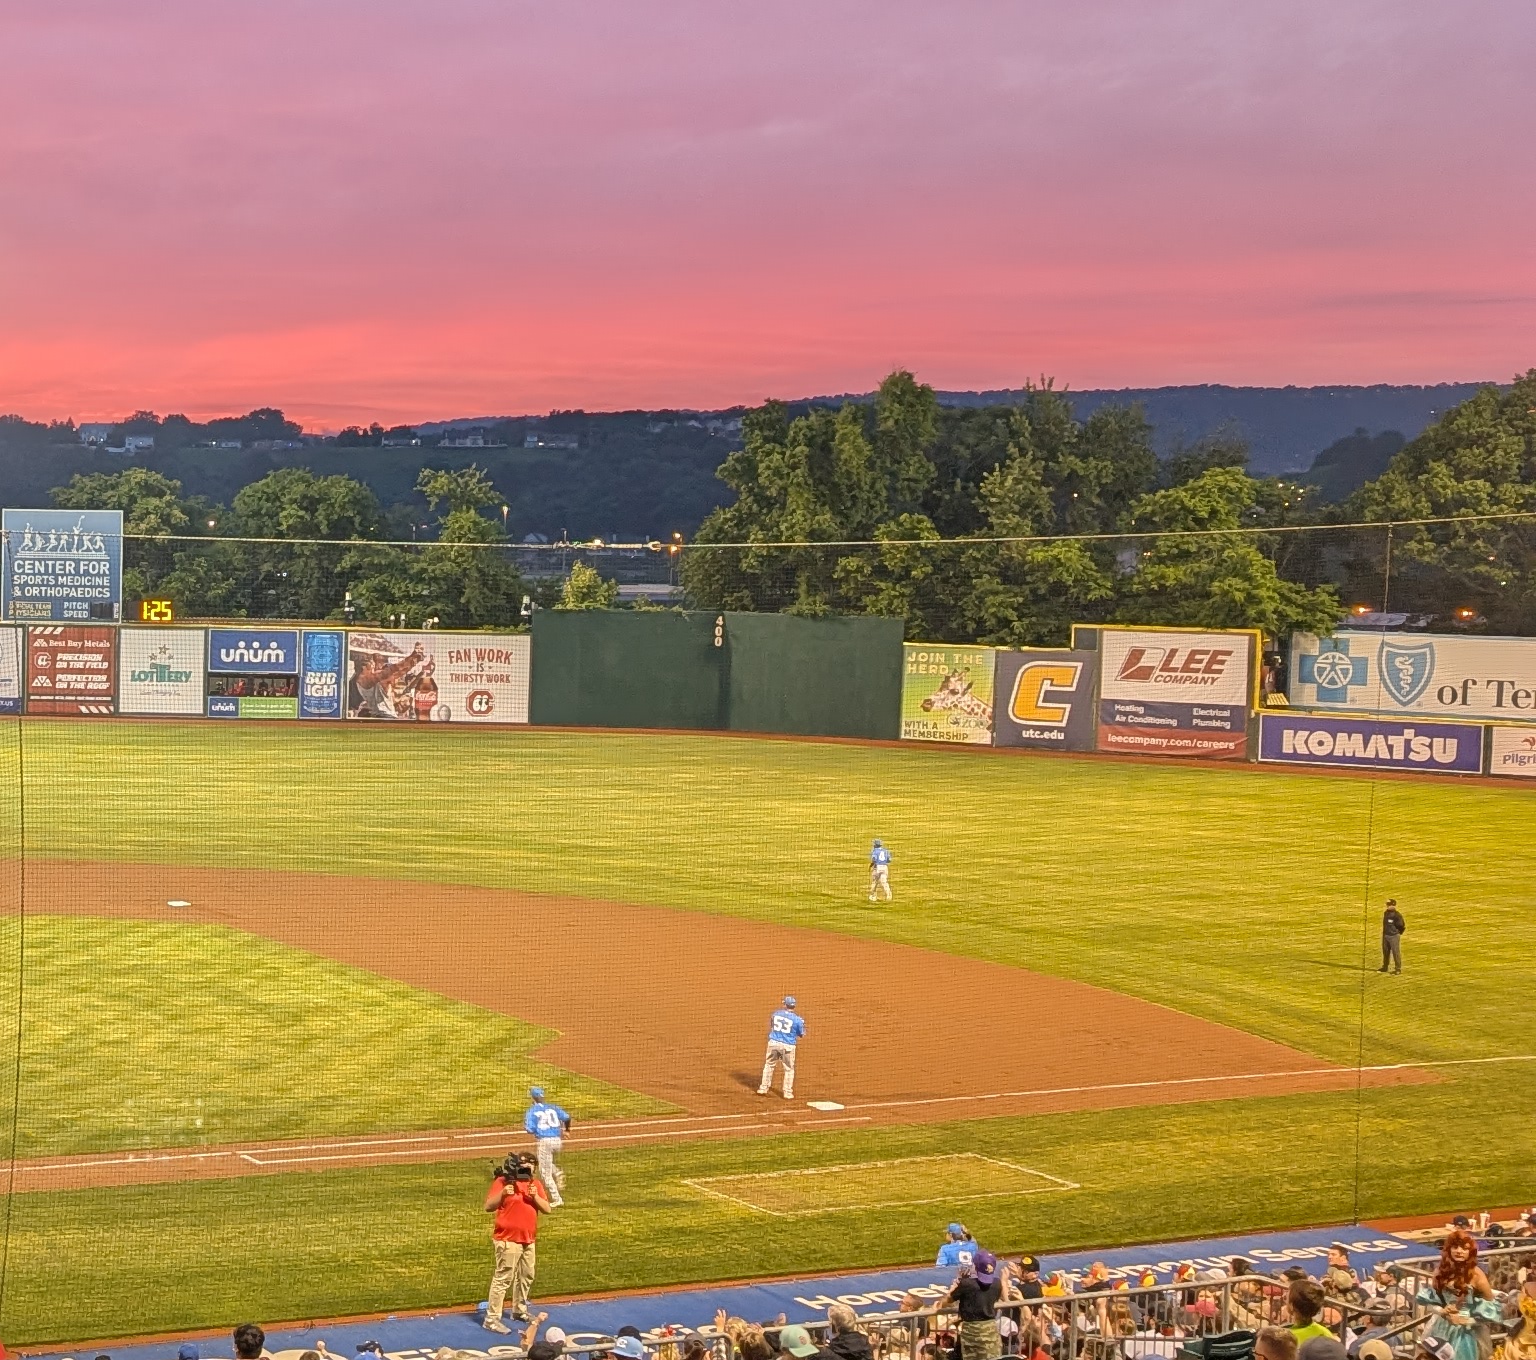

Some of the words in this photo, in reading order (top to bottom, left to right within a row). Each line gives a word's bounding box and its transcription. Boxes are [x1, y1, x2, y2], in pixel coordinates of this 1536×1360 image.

[14, 560, 76, 574] CENTER
[79, 561, 110, 575] FOR
[13, 575, 56, 585] SPORTS
[58, 575, 111, 586] MEDICINE
[13, 587, 22, 597] &
[24, 587, 111, 598] ORTHOPAEDICS
[63, 601, 89, 610] PITCH
[143, 601, 172, 621] 1:25
[63, 610, 89, 619] SPEED
[714, 615, 724, 647] 400
[49, 639, 66, 648] Best
[67, 639, 82, 649] Buy
[84, 639, 111, 648] Metals
[447, 650, 471, 664] FAN
[475, 648, 513, 665] WORK
[907, 652, 946, 663] JOIN
[953, 653, 984, 665] THE
[1159, 648, 1234, 674] LEE
[56, 661, 68, 669] ON
[69, 661, 85, 669] THE
[907, 663, 949, 675] HERD
[305, 671, 337, 685] BUD
[450, 673, 484, 683] THIRSTY
[486, 673, 511, 684] WORK
[1153, 674, 1220, 686] COMPANY
[69, 682, 86, 690] THE
[1436, 678, 1477, 707] of
[1114, 703, 1145, 714] Heating
[1192, 707, 1231, 717] Electrical
[904, 720, 929, 730] WITH
[931, 721, 939, 730] A
[1115, 714, 1126, 722] Air
[1127, 715, 1178, 727] Conditioning
[1192, 718, 1231, 730] Plumbing
[904, 728, 969, 741] MEMBERSHIP
[1022, 729, 1065, 740] utc.edu
[1107, 733, 1235, 749] leecompany.com/careers
[1281, 727, 1458, 764] KOMATSU
[878, 850, 886, 862] 4
[773, 1015, 794, 1034] 53
[534, 1108, 561, 1131] 20
[1248, 1239, 1409, 1262] Serice
